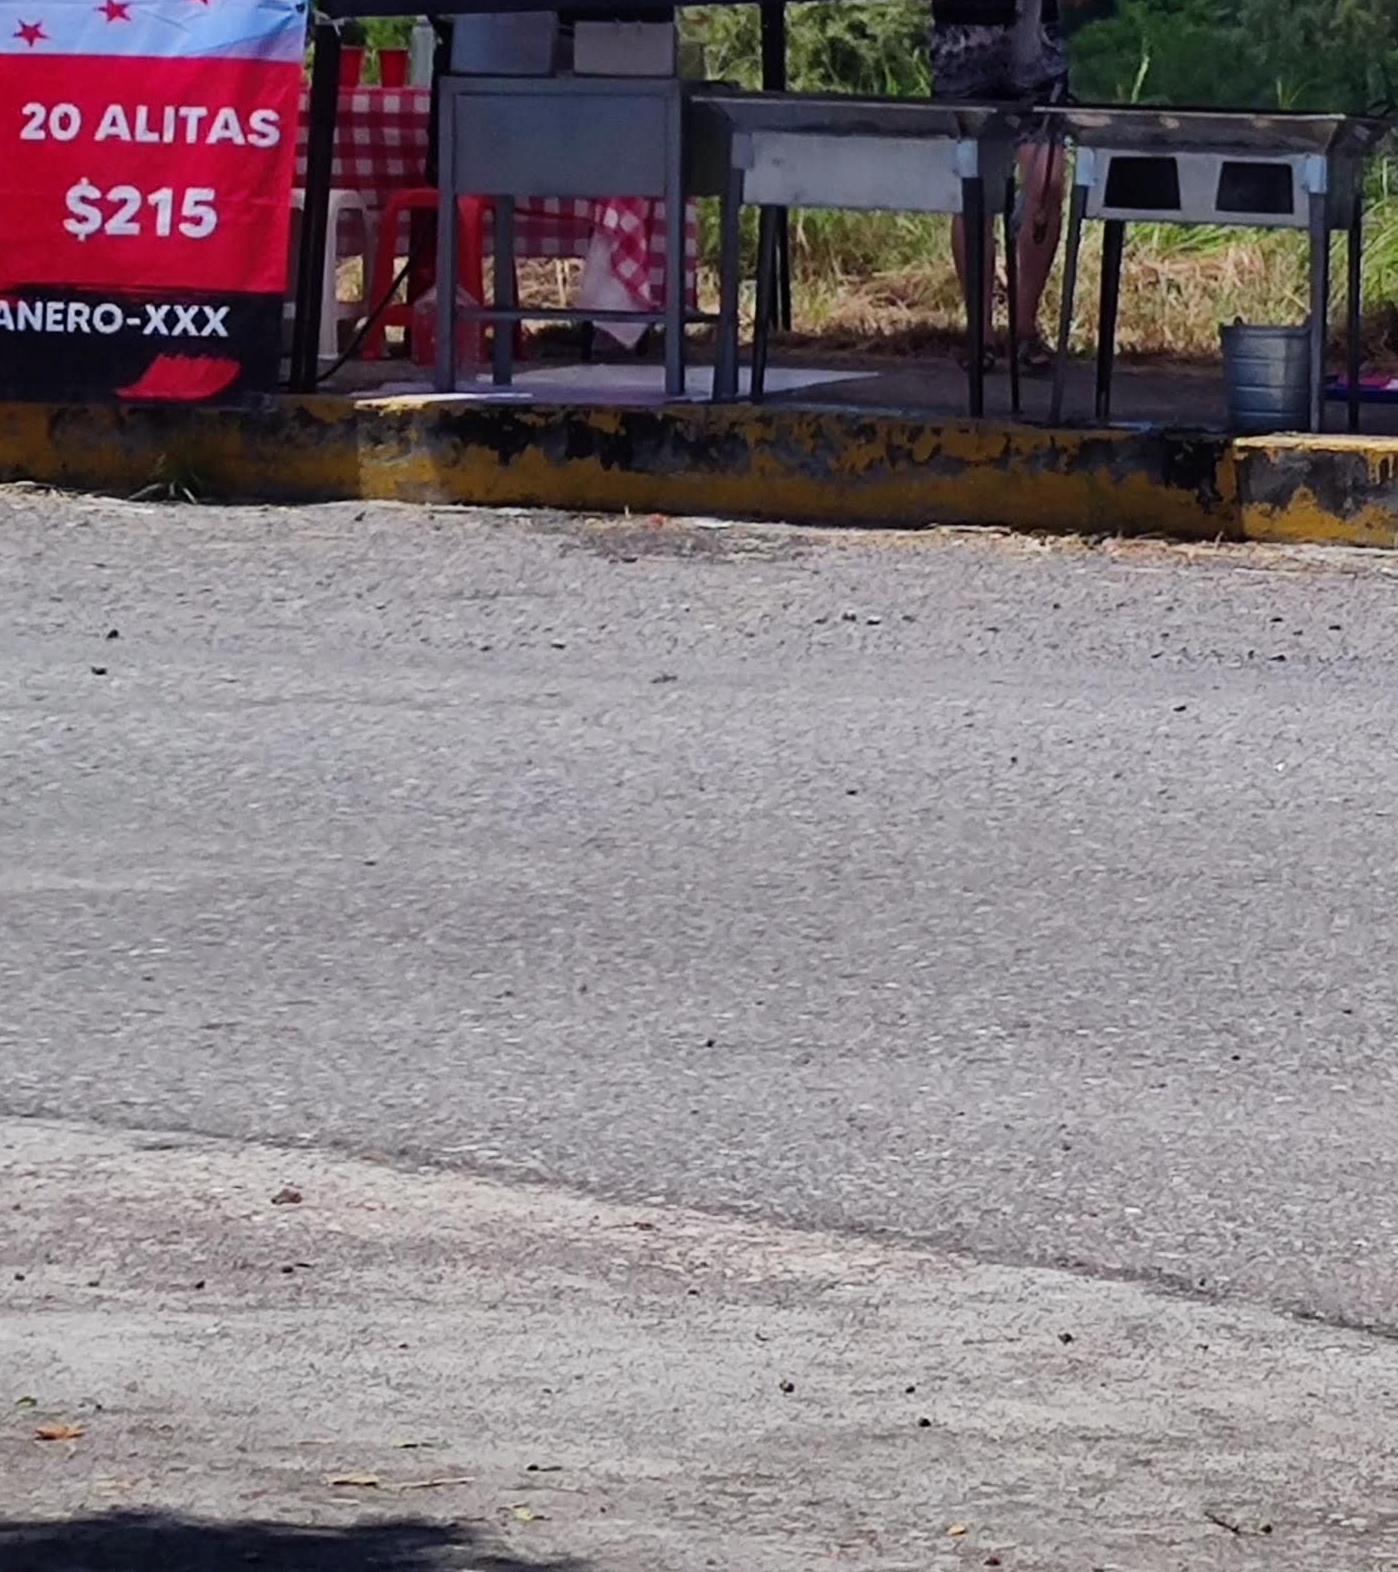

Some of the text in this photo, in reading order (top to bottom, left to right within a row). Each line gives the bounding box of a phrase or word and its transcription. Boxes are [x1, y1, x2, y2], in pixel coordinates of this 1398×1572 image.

[20, 103, 81, 141] 20
[94, 104, 281, 148] ALITAS
[63, 176, 218, 242] $215
